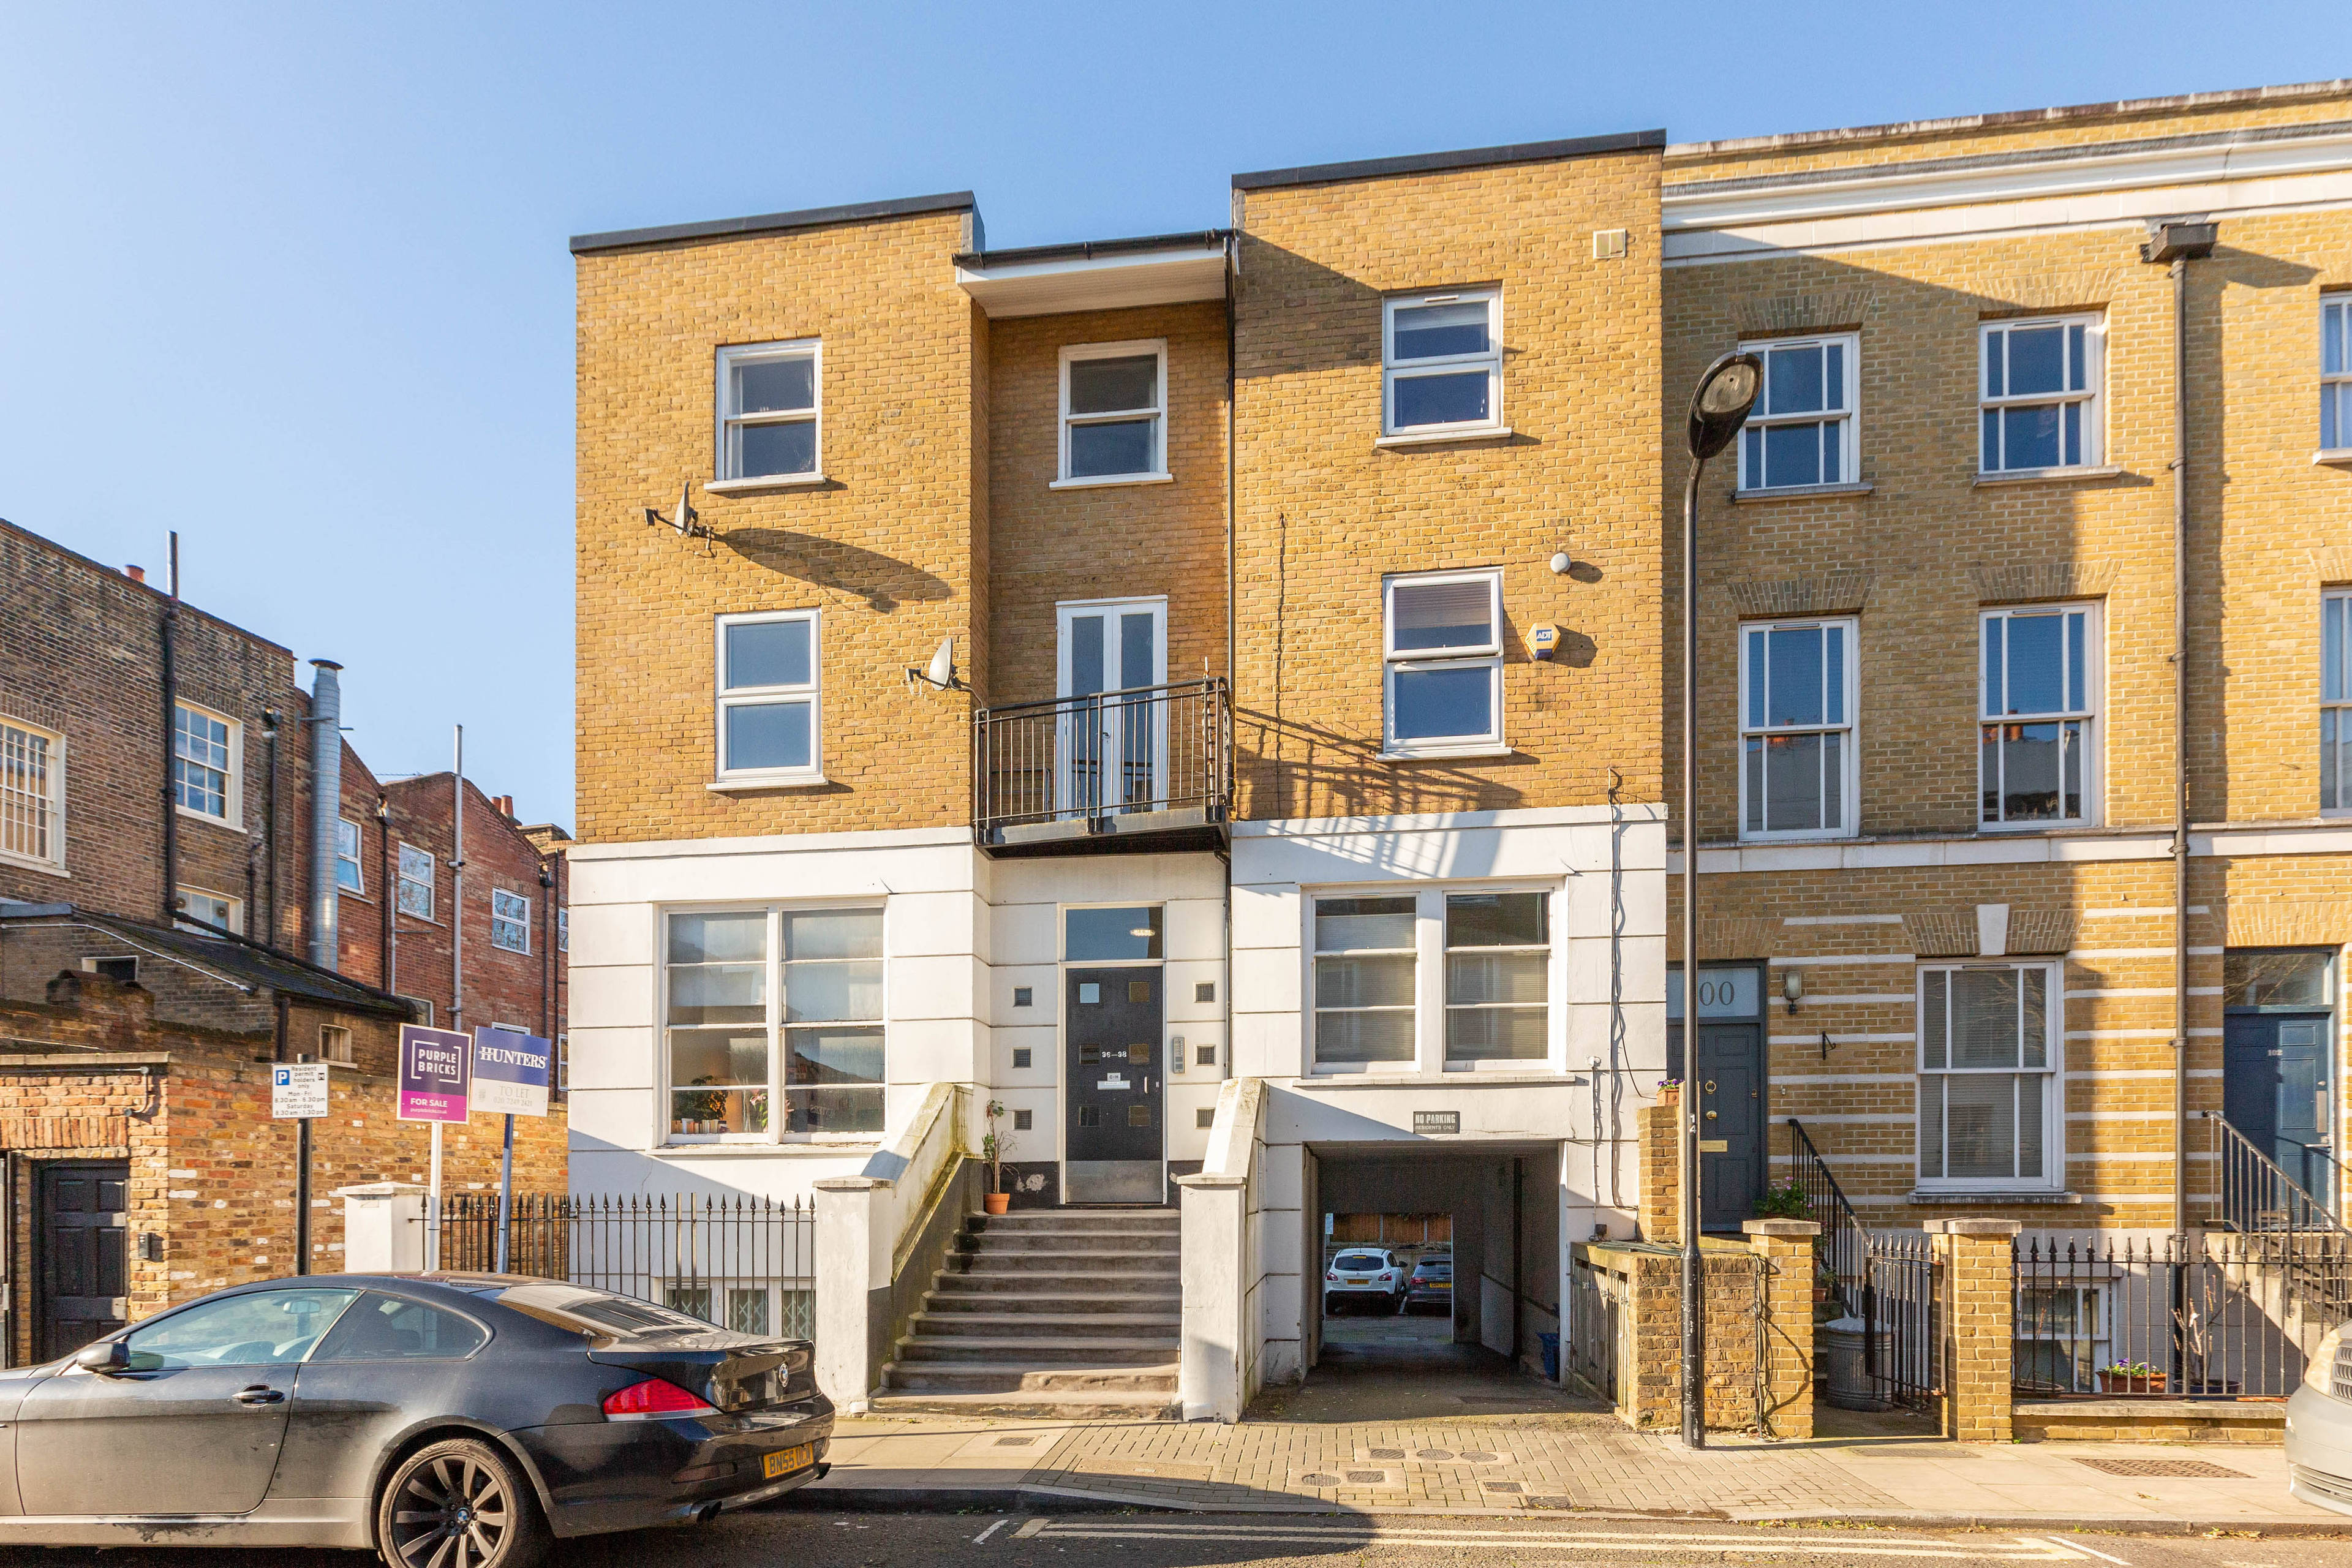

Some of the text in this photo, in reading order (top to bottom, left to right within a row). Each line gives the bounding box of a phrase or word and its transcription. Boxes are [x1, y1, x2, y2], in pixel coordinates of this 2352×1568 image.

[1537, 630, 1552, 640] ADT
[1698, 981, 1735, 1006] 00
[418, 1048, 456, 1064] PURPLE
[478, 1046, 546, 1069] HUNTERS
[418, 1061, 456, 1076] BRICKS
[499, 1085, 513, 1096] TO
[515, 1087, 530, 1098] LET
[410, 1097, 448, 1107] FOR SALE
[1415, 1114, 1456, 1124] NO PARKING
